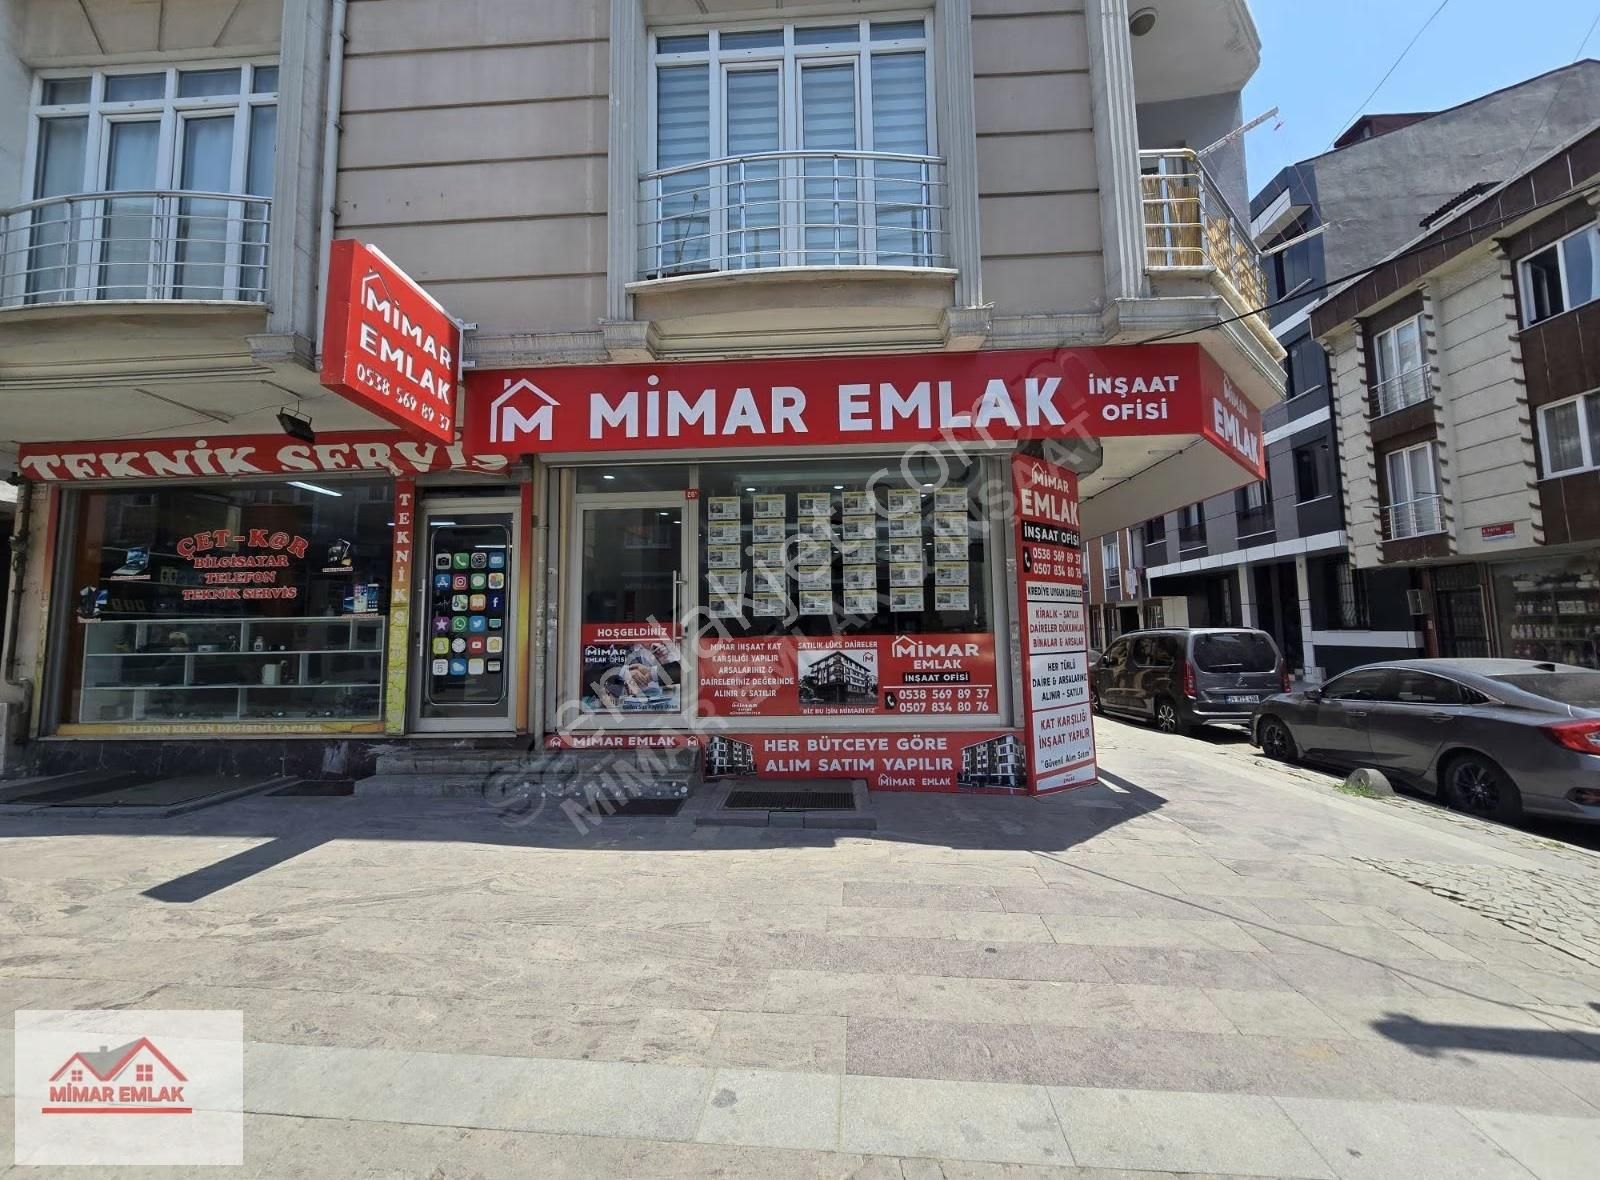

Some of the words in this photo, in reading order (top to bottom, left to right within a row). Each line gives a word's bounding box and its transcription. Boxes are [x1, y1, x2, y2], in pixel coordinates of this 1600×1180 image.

[367, 286, 452, 370] MİMAR
[360, 322, 450, 405] EMLAK
[357, 364, 390, 396] 0538
[396, 387, 417, 411] 569
[1089, 373, 1179, 398] İNŞAAT
[590, 375, 809, 439] MİMAR
[838, 378, 1066, 431] EMLAK
[1102, 398, 1168, 421] OFİSİ
[1213, 398, 1259, 466] EMLAK
[21, 440, 264, 480] TEKNİK
[1034, 470, 1069, 494] MİMAR
[1021, 488, 1079, 526] EMLAK
[1024, 524, 1058, 542] İNŞAAT
[1061, 531, 1080, 546] OFİSİ
[1032, 548, 1050, 560] 0538
[194, 554, 289, 568] BİLGİSAYAR
[1033, 562, 1051, 574] 0507
[205, 571, 276, 584] TELEFON
[182, 586, 241, 600] TEKNİK
[243, 586, 297, 599] SERVİS
[1036, 607, 1057, 618] KİRALIK
[598, 626, 667, 638] HOŞGELDİNİZ
[1030, 622, 1057, 633] DAİRELER
[845, 640, 878, 648] DAİRELER
[897, 641, 979, 657] MİMAR
[587, 648, 626, 656] MİMAR
[914, 660, 961, 669] EMLAK
[1048, 662, 1058, 671] HER
[905, 674, 940, 682] İNŞAAT
[943, 673, 968, 681] OFİSİ
[1033, 676, 1050, 687] DAİRE
[899, 689, 926, 700] 0538
[932, 689, 952, 699] 569
[958, 689, 971, 698] 89
[976, 689, 989, 698] 37
[900, 702, 926, 712] 0507
[932, 702, 952, 712] 834
[958, 702, 971, 712] 80
[976, 702, 988, 711] 76
[1041, 719, 1054, 730] KAT
[573, 735, 623, 746] MİMAR
[628, 737, 676, 746] EMLAK
[764, 740, 799, 752] HER
[896, 735, 947, 750] GÖRE
[1039, 735, 1065, 750] İNŞAAT
[1069, 728, 1090, 742] YAPILIR
[765, 759, 810, 772] ALIM
[818, 759, 874, 771] SATIM
[882, 758, 952, 771] YAPILIR
[881, 776, 915, 786] MİMAR
[922, 778, 950, 786] EMLAK
